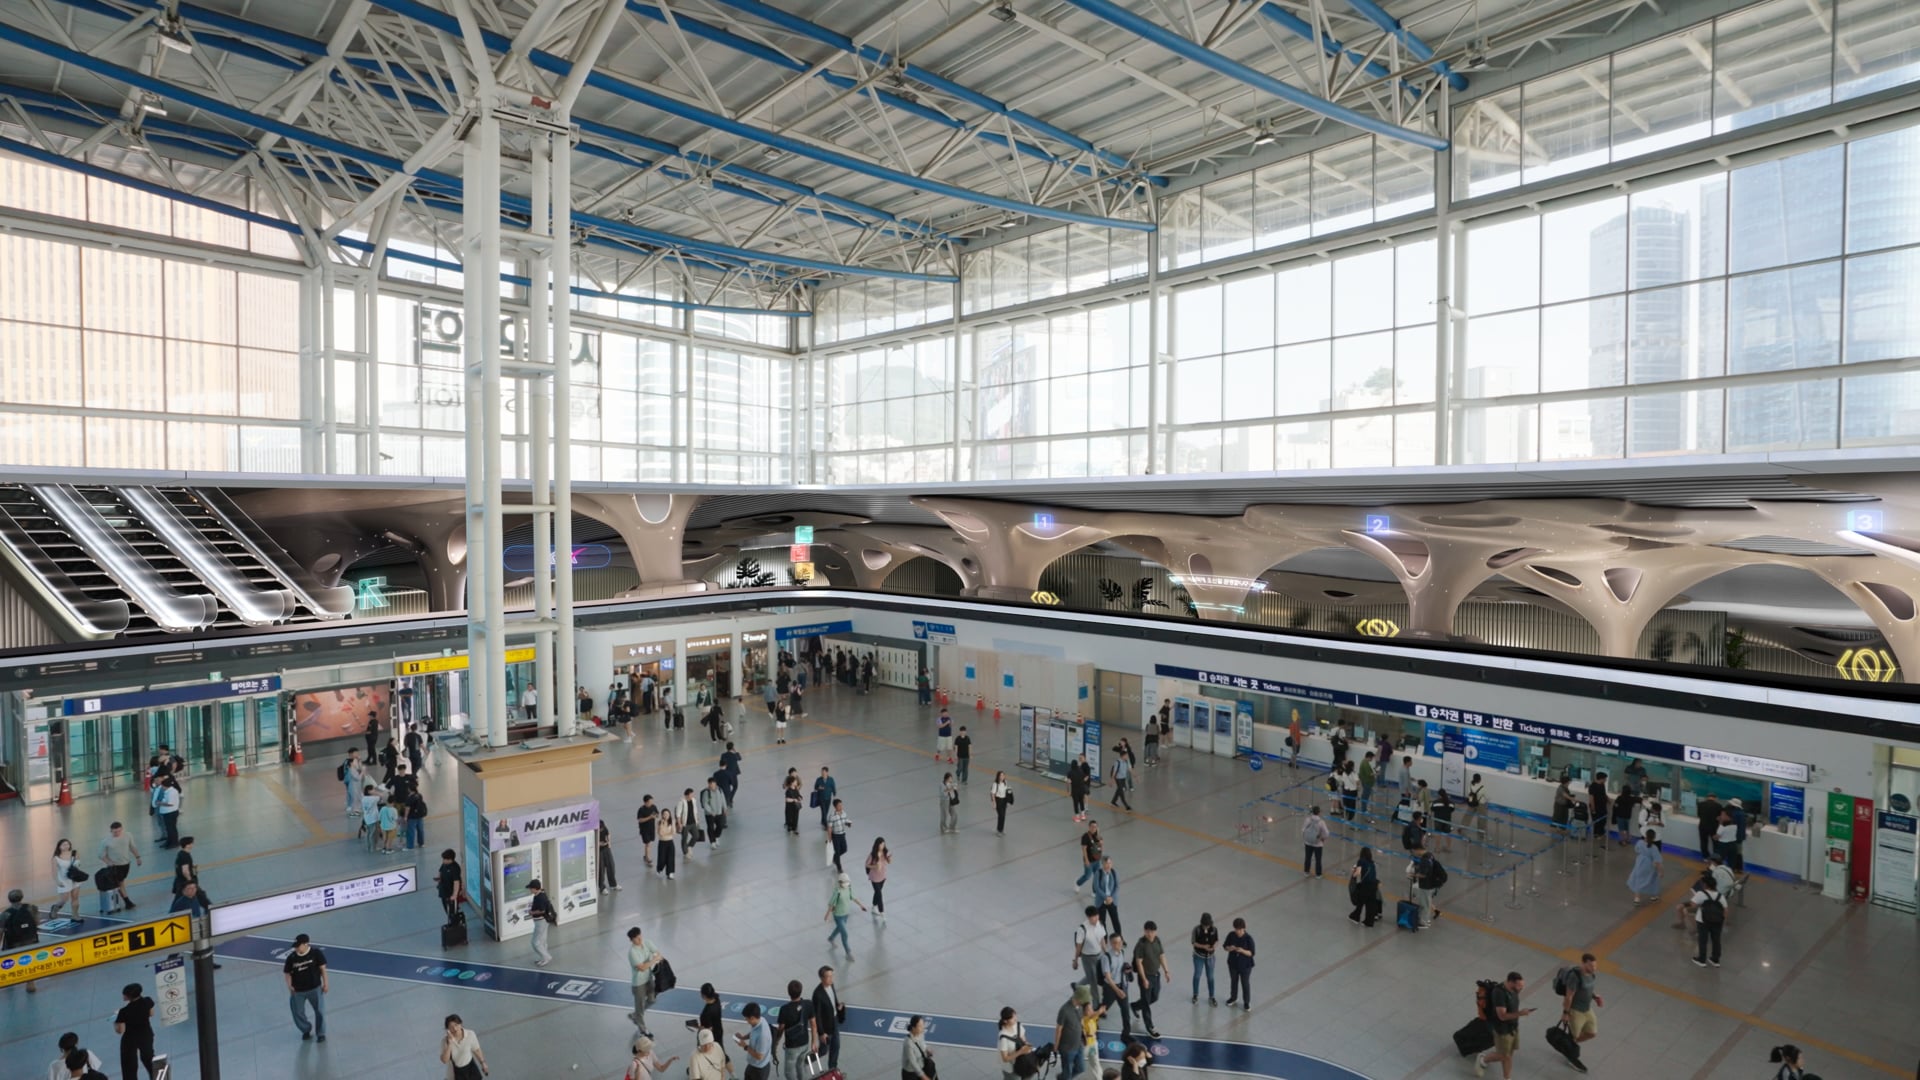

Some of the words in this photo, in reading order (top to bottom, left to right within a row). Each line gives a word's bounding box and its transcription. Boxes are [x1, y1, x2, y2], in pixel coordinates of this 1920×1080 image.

[1040, 517, 1047, 528] 1
[1372, 518, 1384, 532] 2
[1857, 514, 1873, 530] 3
[1209, 674, 1230, 685] 승차권
[1232, 676, 1248, 688] 사는
[1250, 679, 1259, 690] 곳
[1263, 682, 1281, 692] Tickets
[1430, 707, 1460, 721] 승차권
[1463, 712, 1483, 726] 변경
[1492, 716, 1514, 731] 반환
[1519, 723, 1546, 735] Tickets
[524, 809, 590, 833] NAMANE
[137, 931, 146, 946] 1
